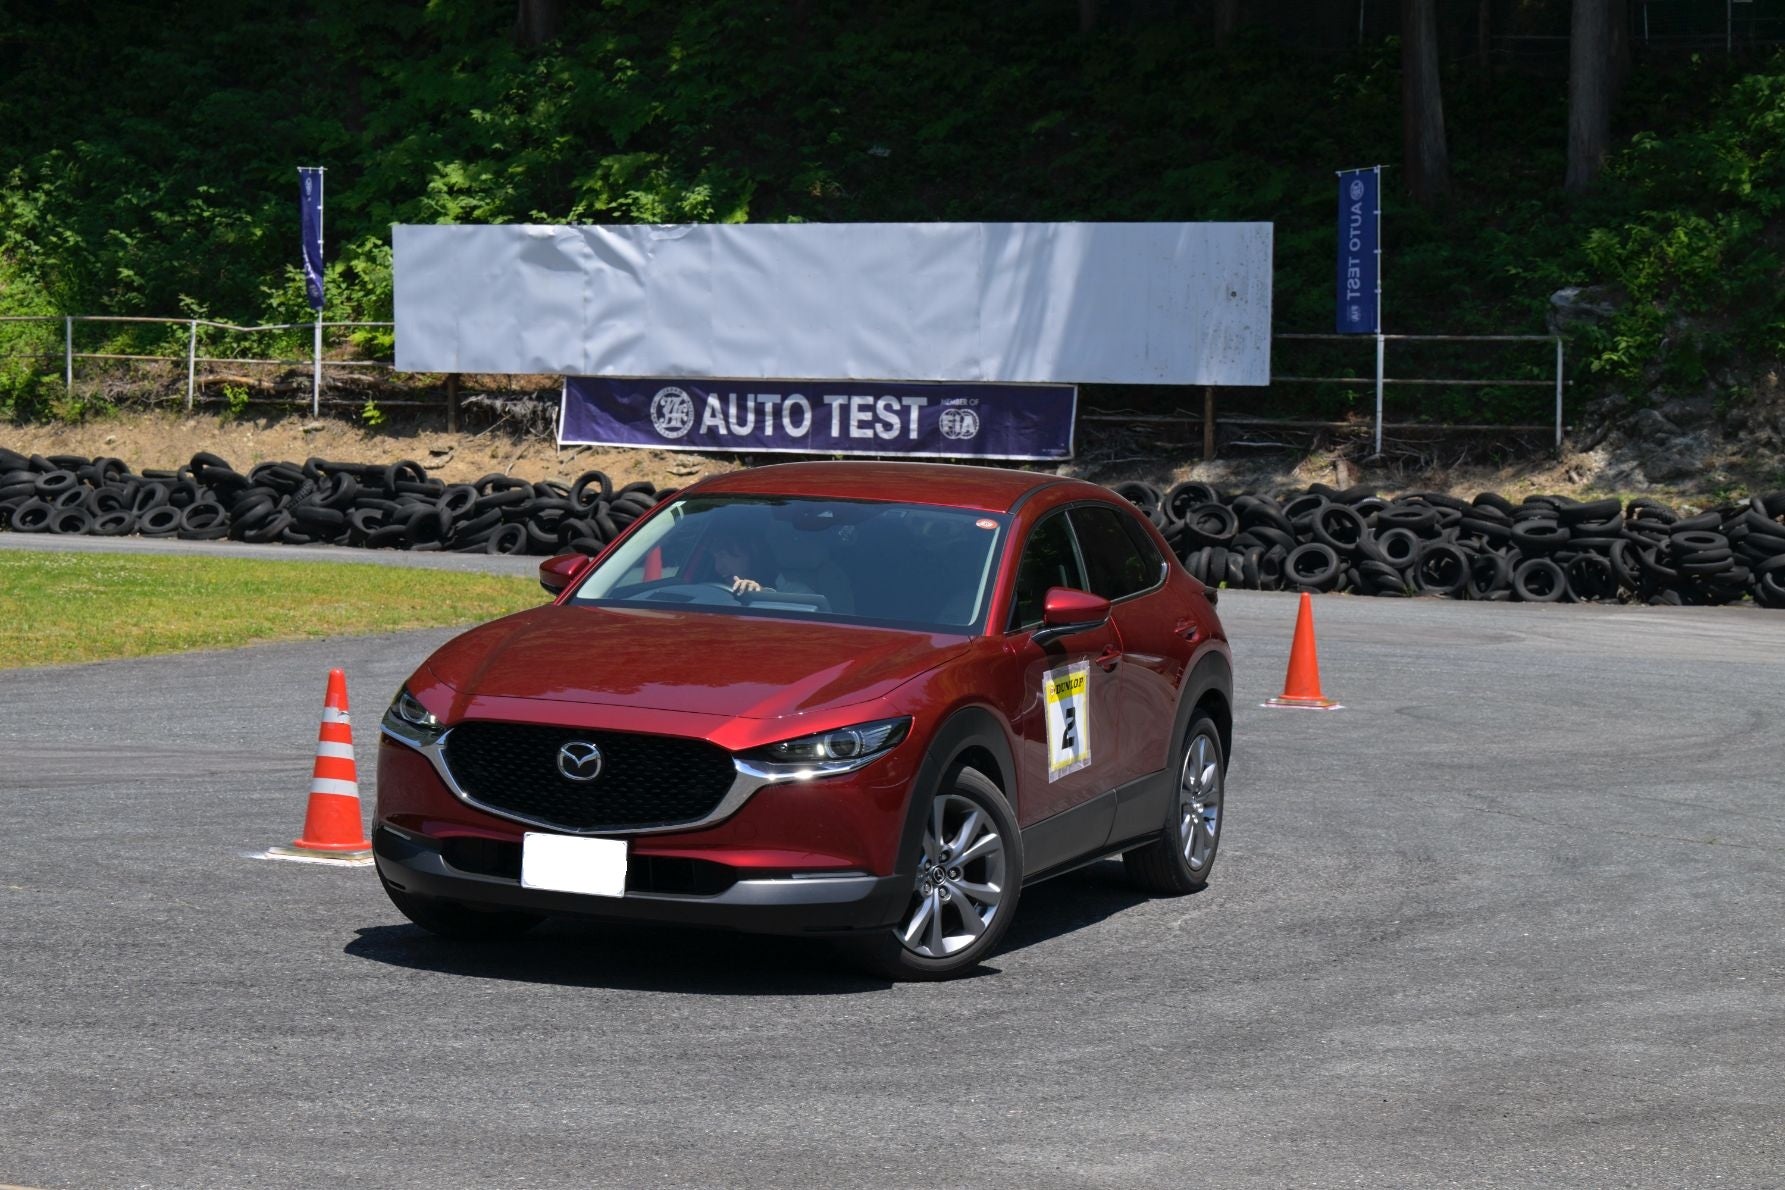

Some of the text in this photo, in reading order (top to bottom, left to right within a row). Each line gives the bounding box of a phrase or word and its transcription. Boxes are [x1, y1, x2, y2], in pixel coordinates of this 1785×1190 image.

[700, 393, 812, 436] AUTO
[823, 396, 928, 439] TEST
[1055, 677, 1084, 694] DUNLOP
[1062, 706, 1076, 750] 2
